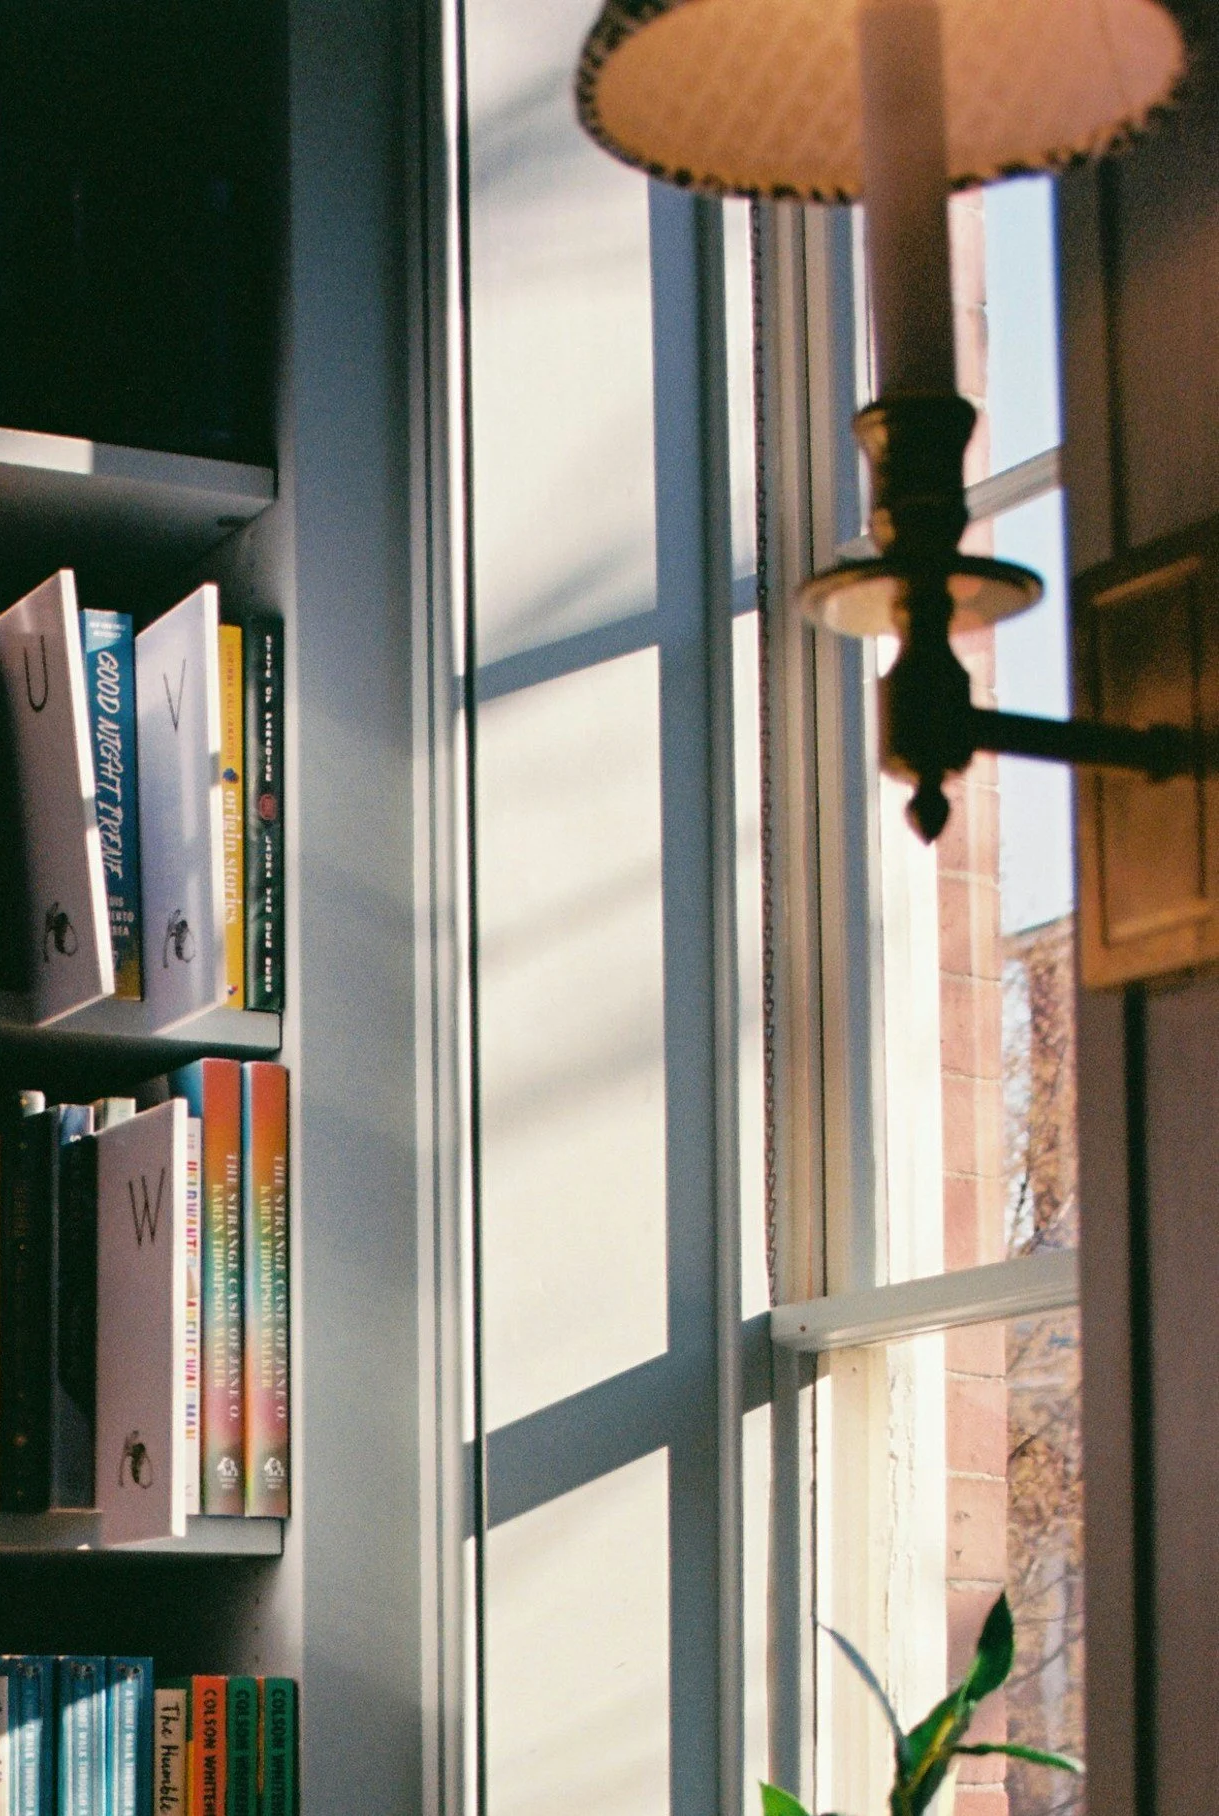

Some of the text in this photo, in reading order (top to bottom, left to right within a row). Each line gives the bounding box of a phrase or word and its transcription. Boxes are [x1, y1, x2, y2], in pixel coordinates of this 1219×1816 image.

[95, 653, 121, 714] GOOD
[275, 1155, 285, 1188] THE
[275, 1195, 286, 1274] STRANGE
[259, 1186, 272, 1388] KAREN THOMPSON WALKER
[275, 1279, 286, 1321] CASE
[276, 1328, 286, 1349] OF
[275, 1357, 286, 1405] JANE
[203, 1688, 218, 1749] COLSON
